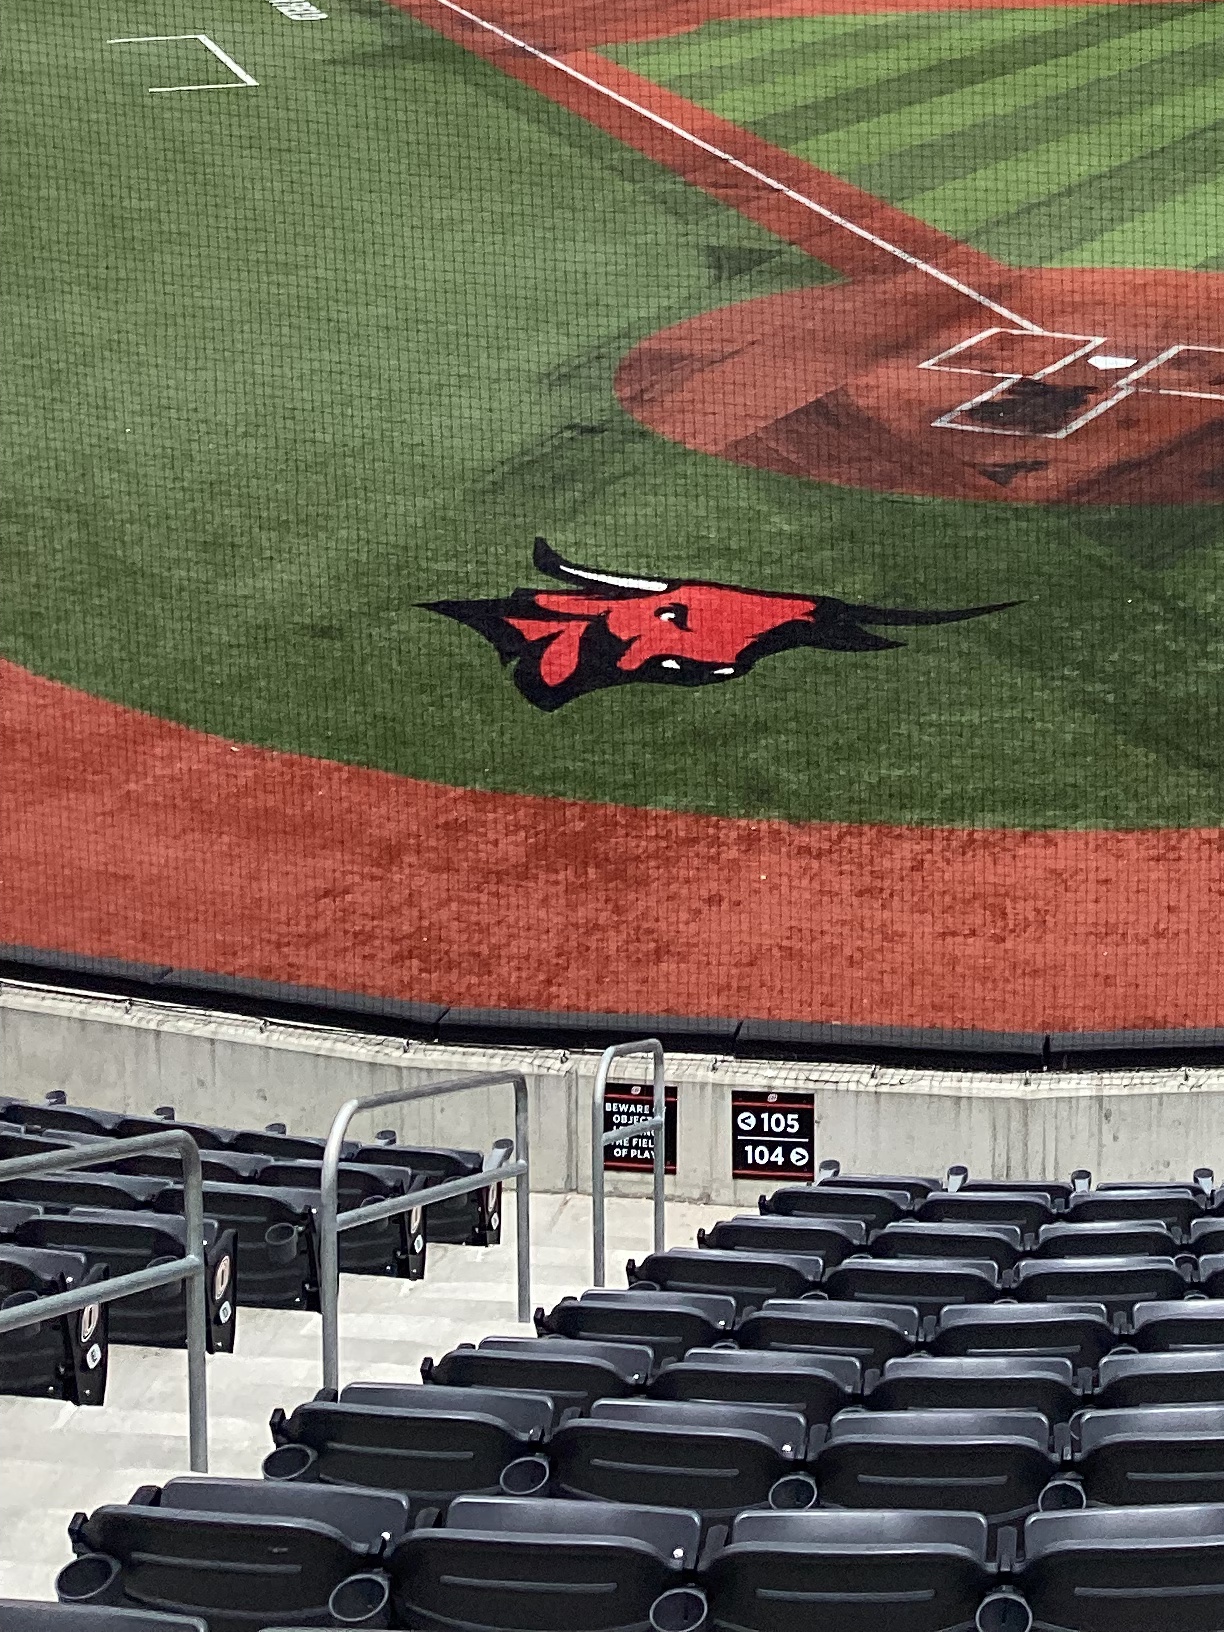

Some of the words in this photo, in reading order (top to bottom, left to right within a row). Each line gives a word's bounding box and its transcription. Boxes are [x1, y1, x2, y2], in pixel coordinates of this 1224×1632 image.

[605, 1102, 650, 1114] BEWARE
[612, 1114, 655, 1125] OBJECT
[761, 1112, 800, 1133] 105
[632, 1137, 655, 1148] FIEL
[613, 1148, 628, 1158] OF
[744, 1145, 785, 1166] 104
